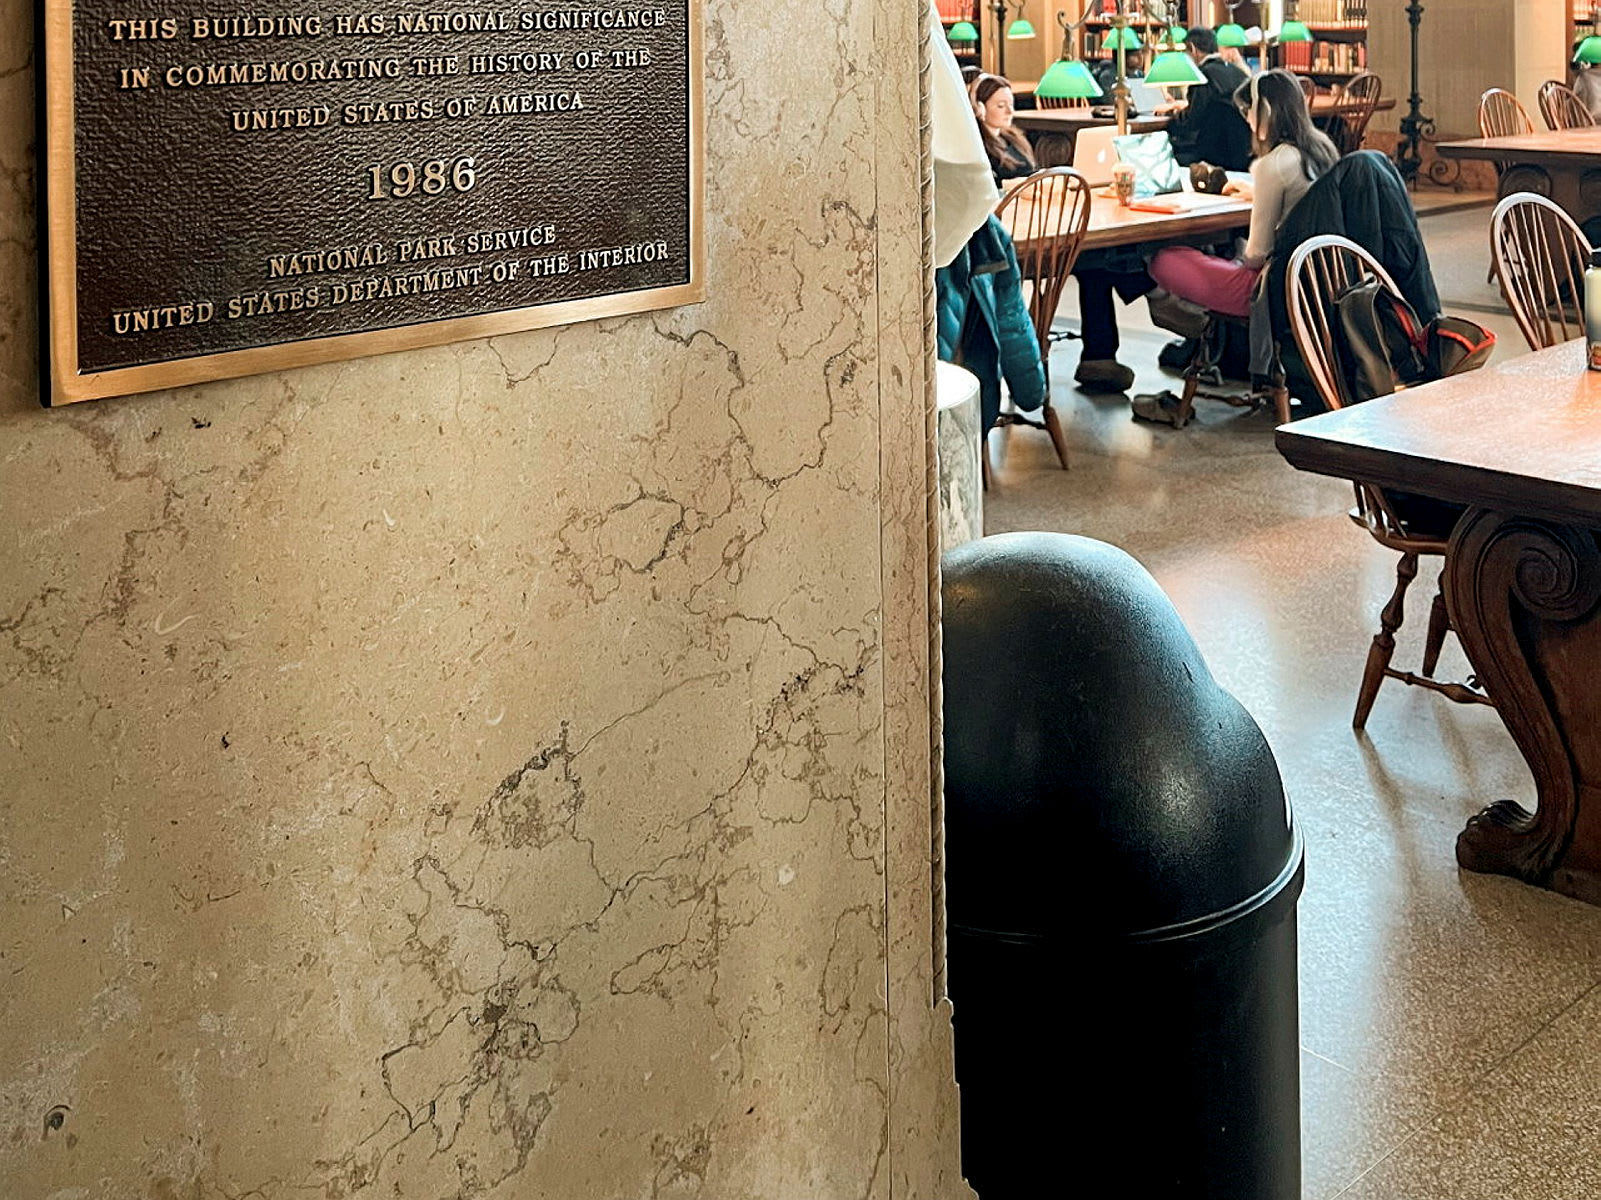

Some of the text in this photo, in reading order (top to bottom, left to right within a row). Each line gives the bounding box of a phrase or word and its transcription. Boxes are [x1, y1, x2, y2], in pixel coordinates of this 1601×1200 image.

[109, 9, 665, 40] THIS BUILDING HAS NATIONAL SIGNIFICANCE
[120, 49, 651, 89] IN COMMEMORATING THE HISTORY OF THE
[233, 92, 584, 131] UNITED STATES OF AMERICA
[369, 156, 475, 199] 1986
[270, 225, 556, 278] NATIONAL PARK SERVICE
[113, 242, 668, 334] UNITED STATES DEPARTMENT OF THE INTERIOR
